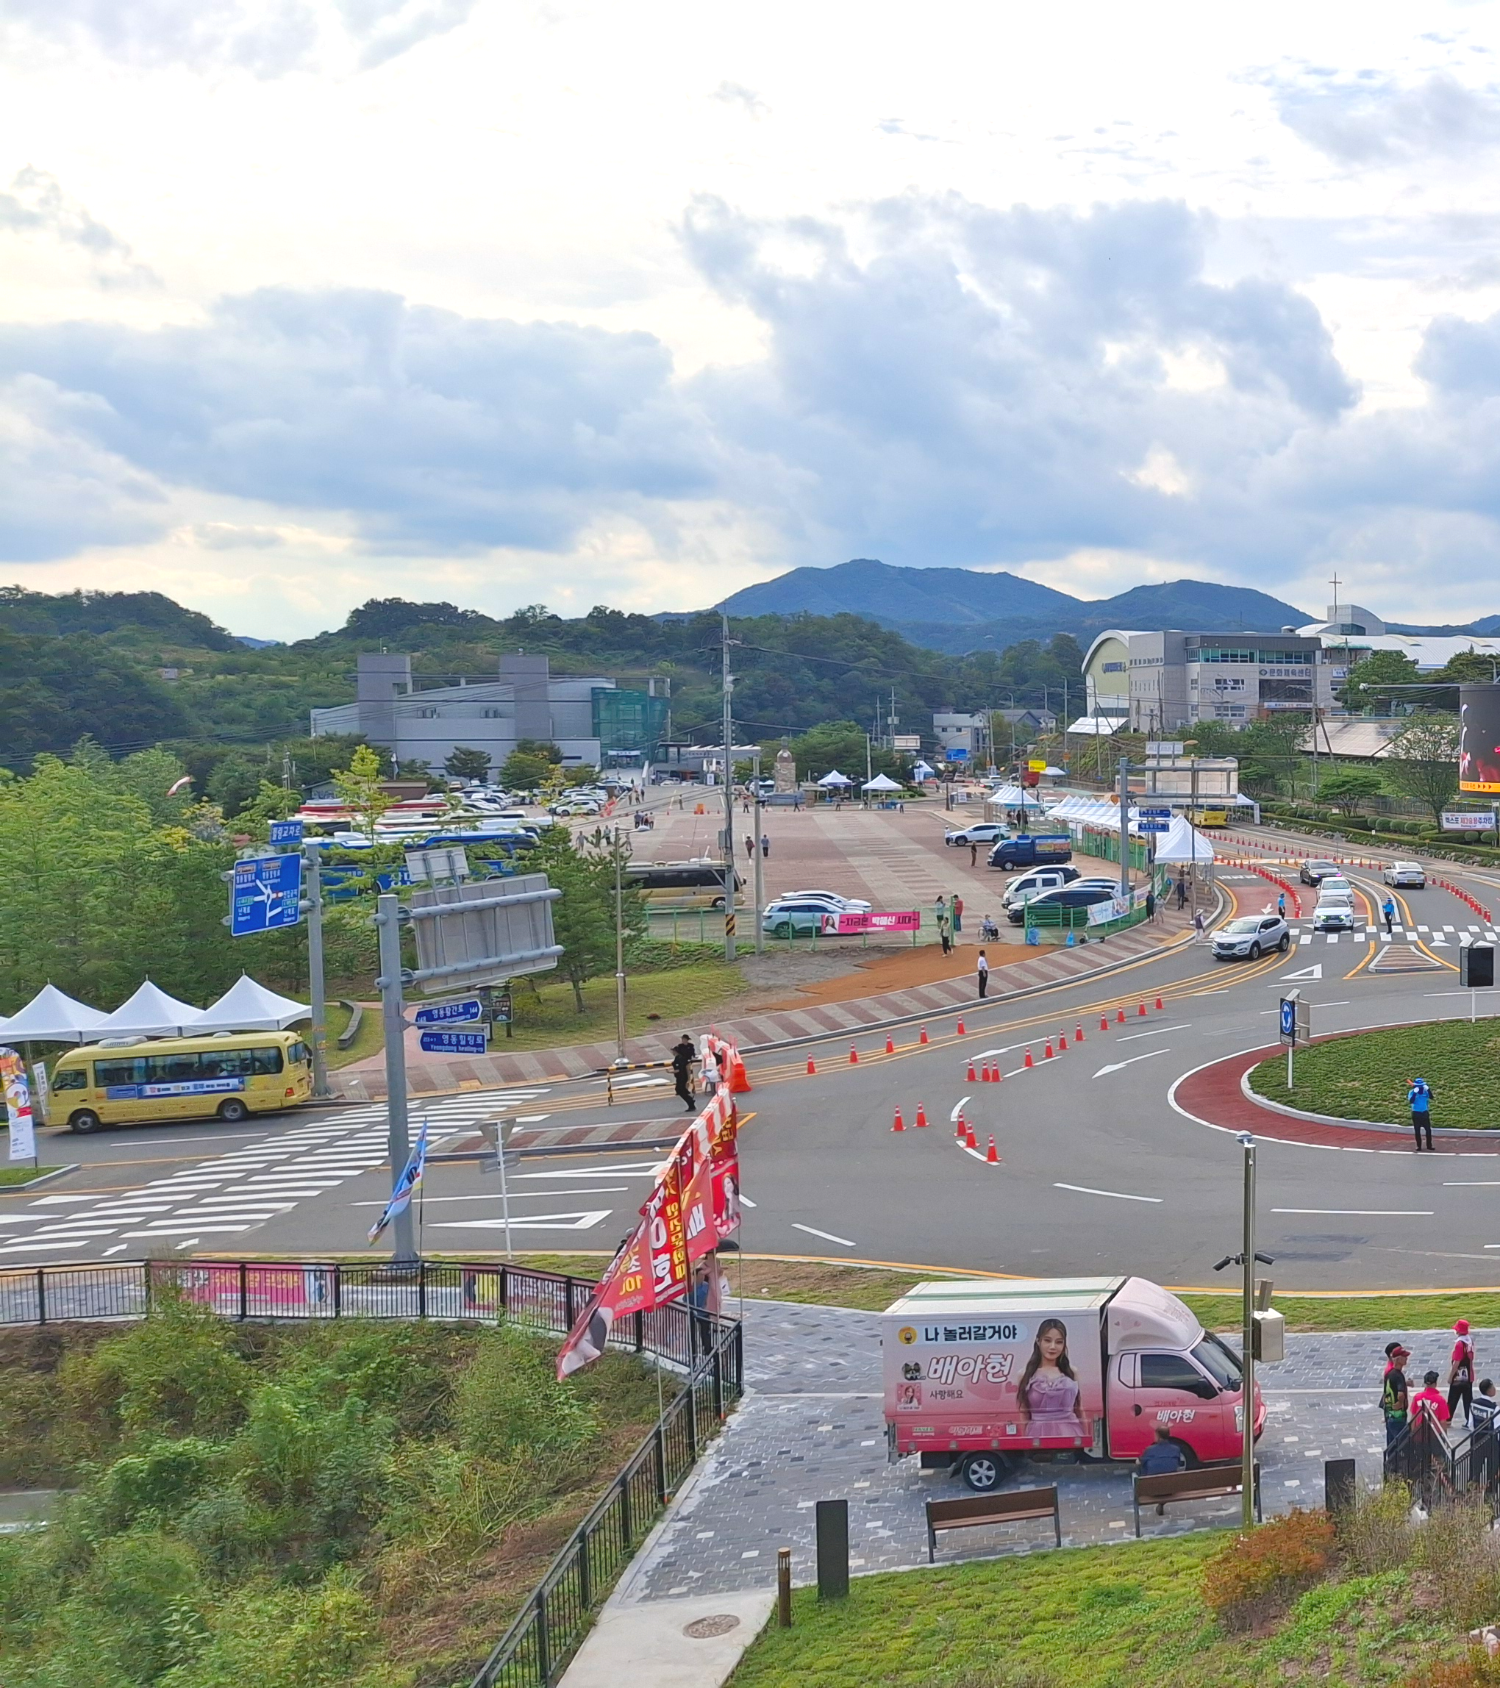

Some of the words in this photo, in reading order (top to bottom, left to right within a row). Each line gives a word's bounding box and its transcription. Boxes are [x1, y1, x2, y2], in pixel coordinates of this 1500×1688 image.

[1269, 668, 1311, 678] 문화체육센터
[272, 825, 301, 841] 힐링교차로
[432, 1004, 465, 1019] 영동황간로
[442, 1034, 484, 1046] 영동힐링로
[924, 1326, 939, 1342] 나
[943, 1324, 1018, 1342] 놀러갈거야
[926, 1352, 1014, 1385] 배아현
[929, 1389, 965, 1400] 사랑해요
[1156, 1409, 1196, 1423] 배아현
